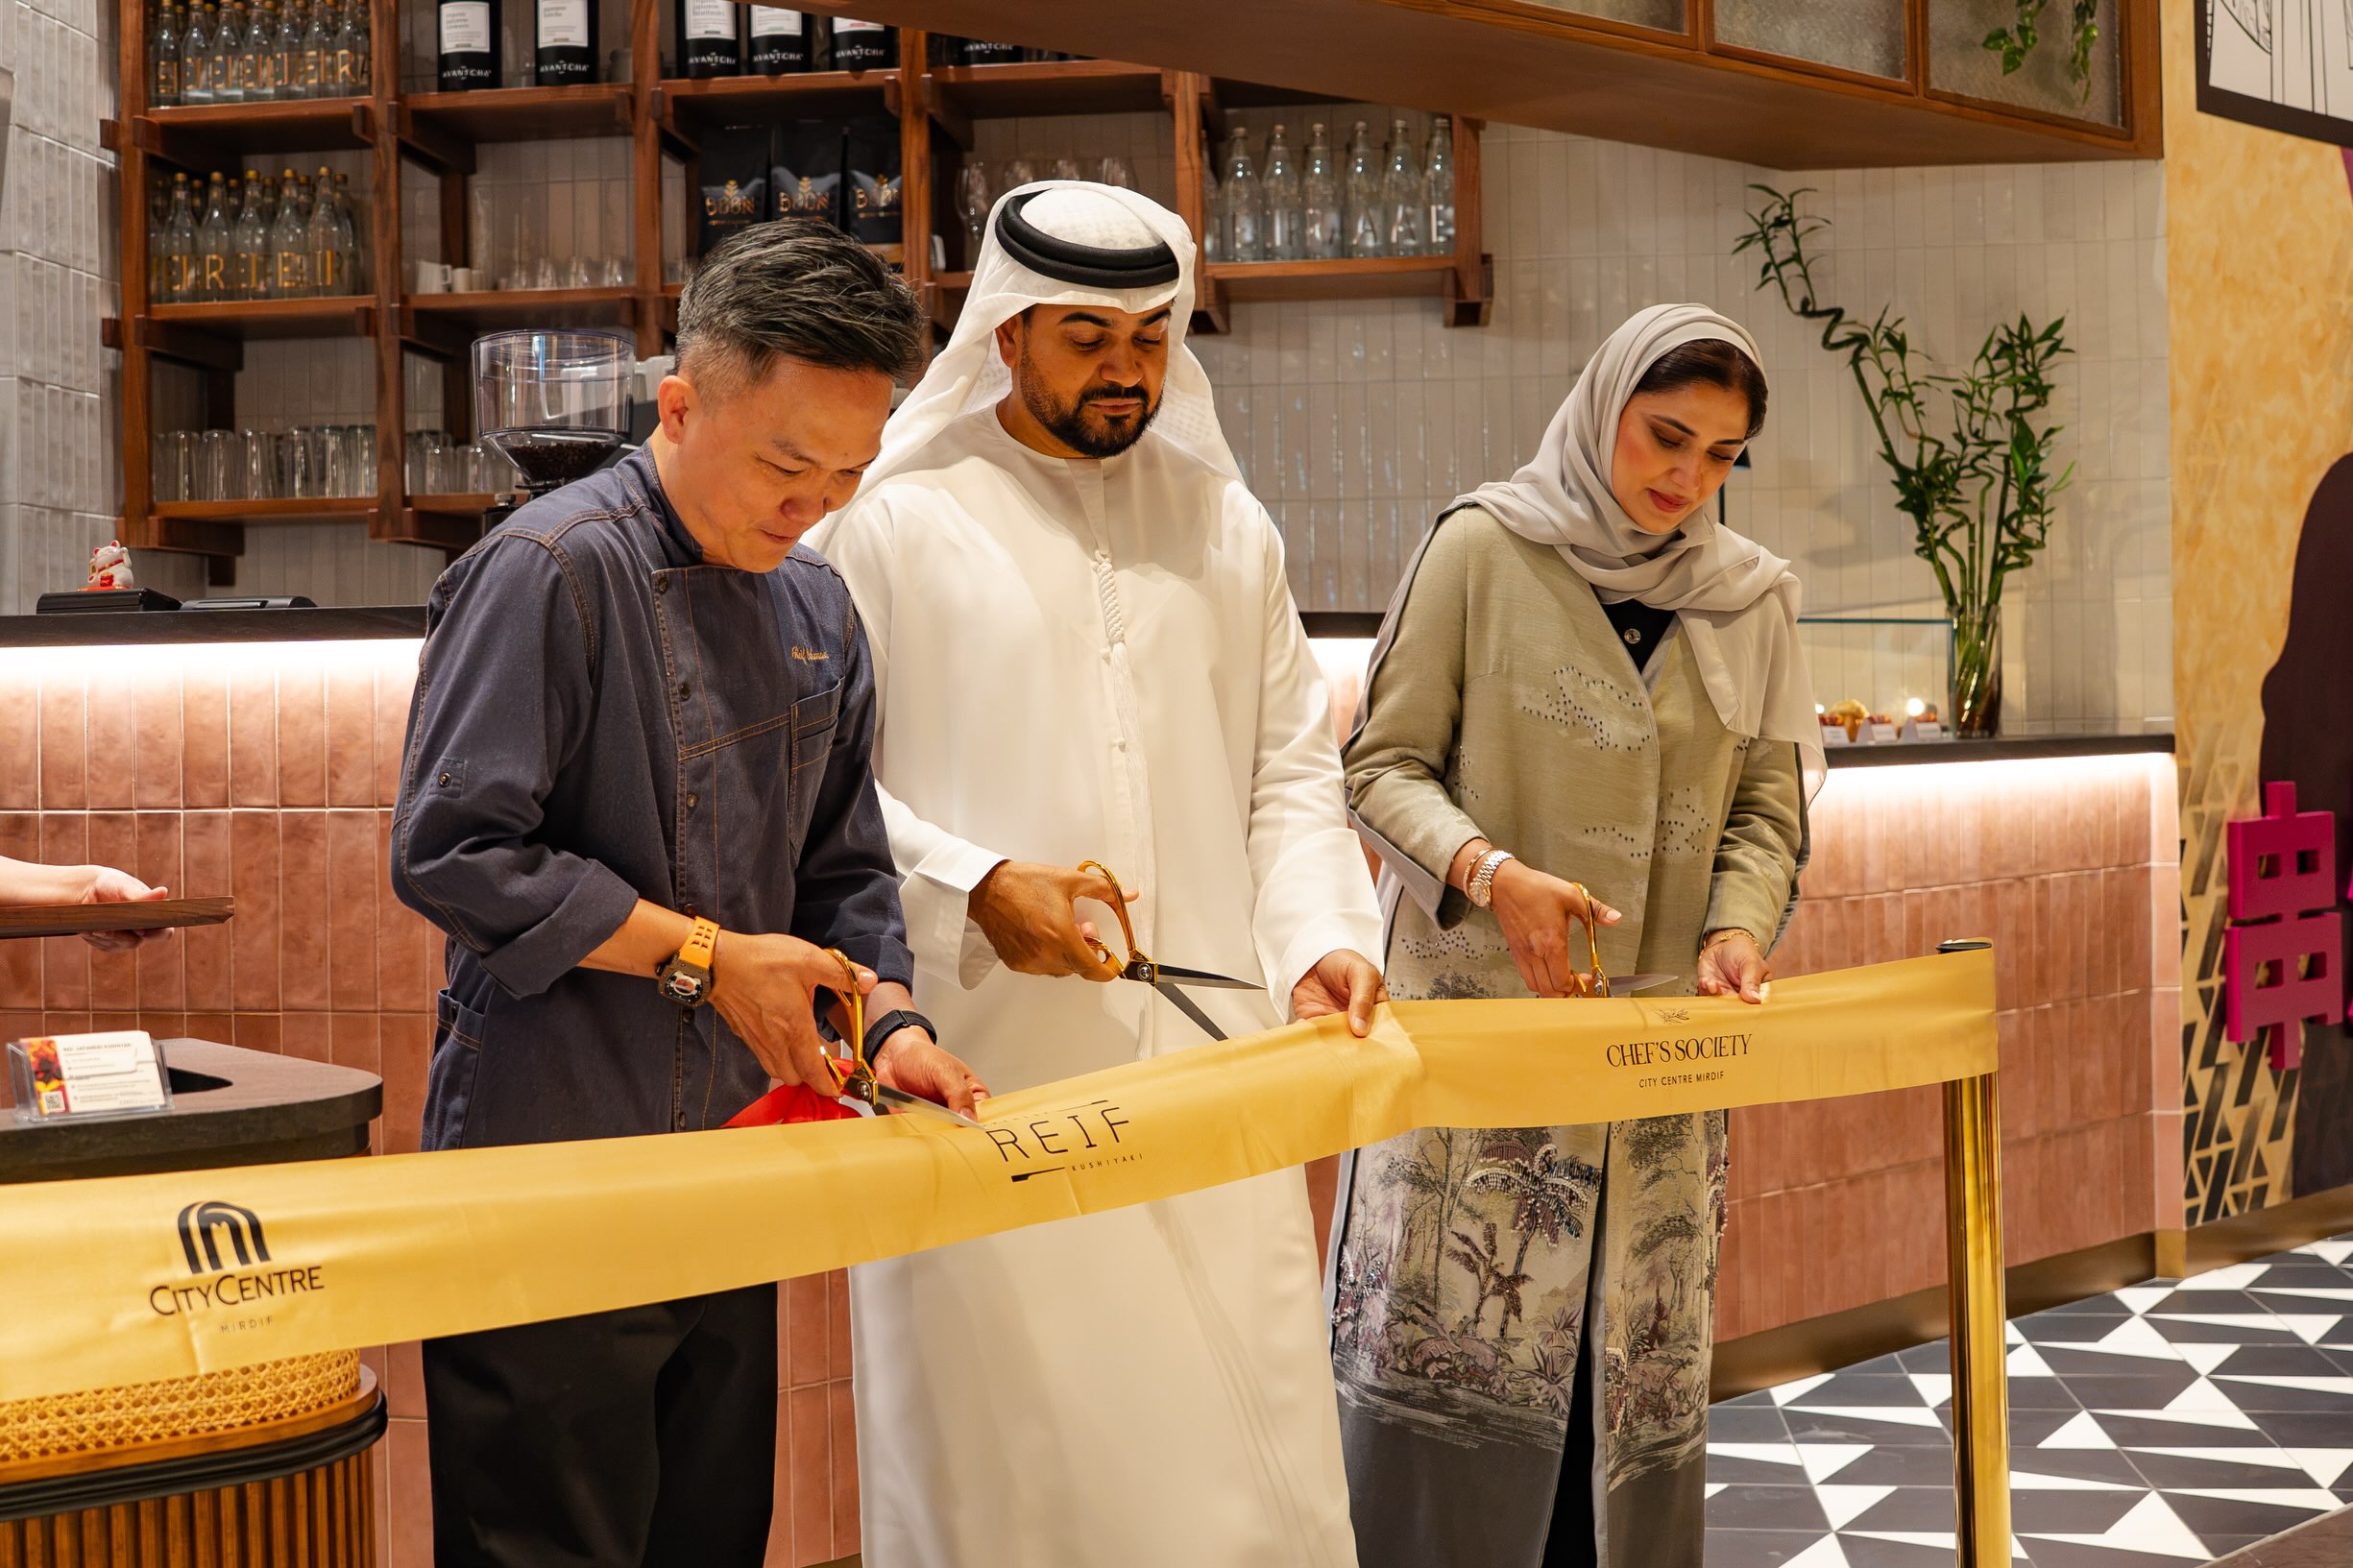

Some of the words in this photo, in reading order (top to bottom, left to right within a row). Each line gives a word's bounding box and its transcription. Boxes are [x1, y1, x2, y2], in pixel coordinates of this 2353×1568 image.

[1606, 1040, 1671, 1067] CHEF'S
[1674, 1033, 1753, 1062] SOCIETY
[1638, 1076, 1658, 1088] CITY
[1662, 1073, 1693, 1086] CENTRE
[1696, 1071, 1725, 1082] MIRDIF
[985, 1106, 1129, 1162] REIF
[1072, 1153, 1143, 1171] KUSHIYAKI
[220, 1315, 274, 1334] MIRDIF
